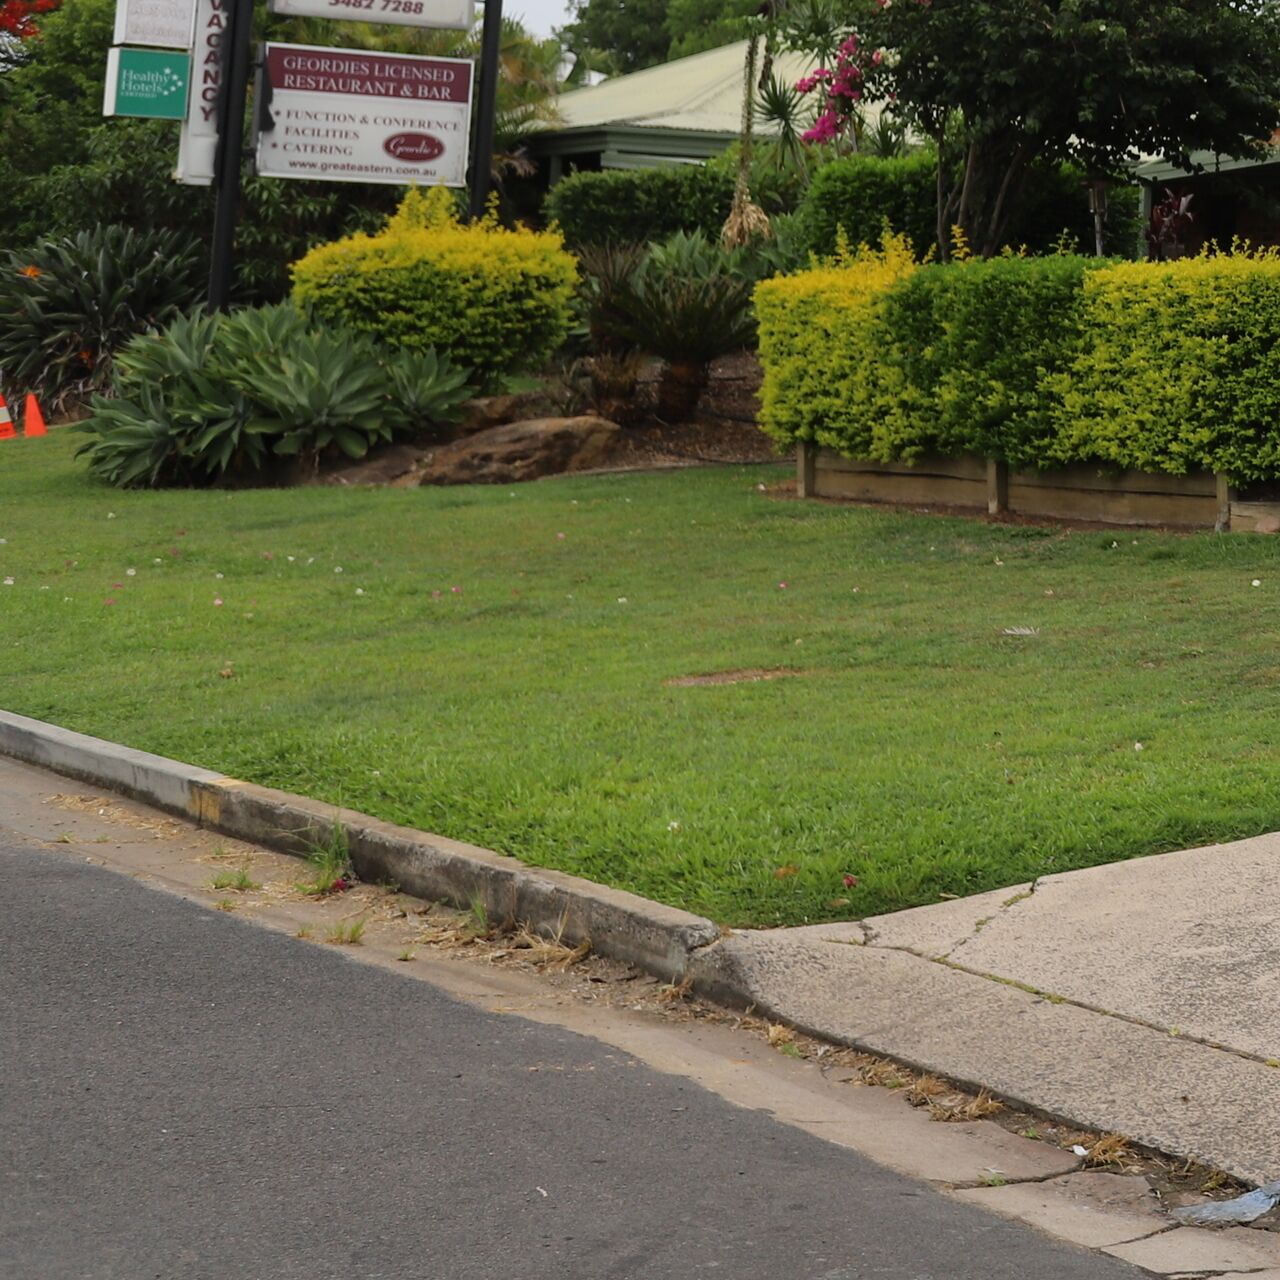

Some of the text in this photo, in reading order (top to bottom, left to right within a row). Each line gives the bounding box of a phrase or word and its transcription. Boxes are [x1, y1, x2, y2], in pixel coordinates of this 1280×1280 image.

[380, 0, 424, 15] 7288
[122, 69, 171, 86] Healthy
[283, 56, 455, 82] GEORDIES LICENSED
[120, 80, 163, 93] Hotels
[284, 75, 451, 100] RESTAURANT & BAR
[286, 109, 460, 132] FUNCTION & CONFERENCE
[284, 126, 360, 140] FACILITIES
[283, 142, 353, 156] CATERING
[289, 160, 437, 177] www.greateastern.com.au
